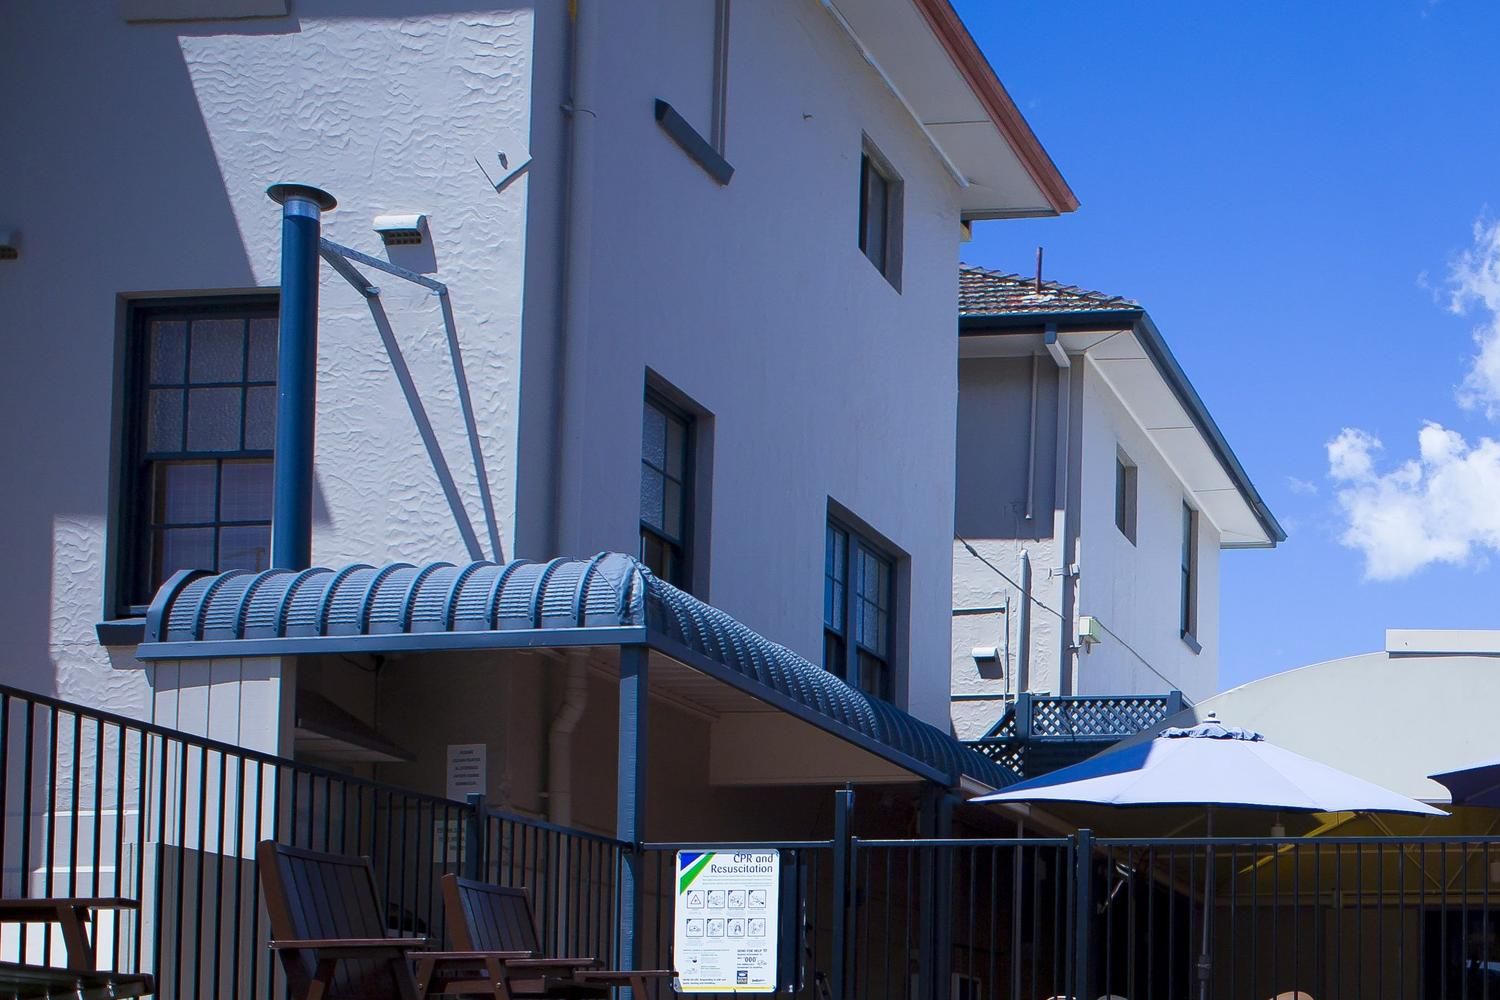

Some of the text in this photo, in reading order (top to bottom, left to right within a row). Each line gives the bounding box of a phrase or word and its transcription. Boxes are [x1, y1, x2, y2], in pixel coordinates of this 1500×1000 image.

[733, 853, 774, 863] CPR and
[710, 864, 773, 873] Resuscitation
